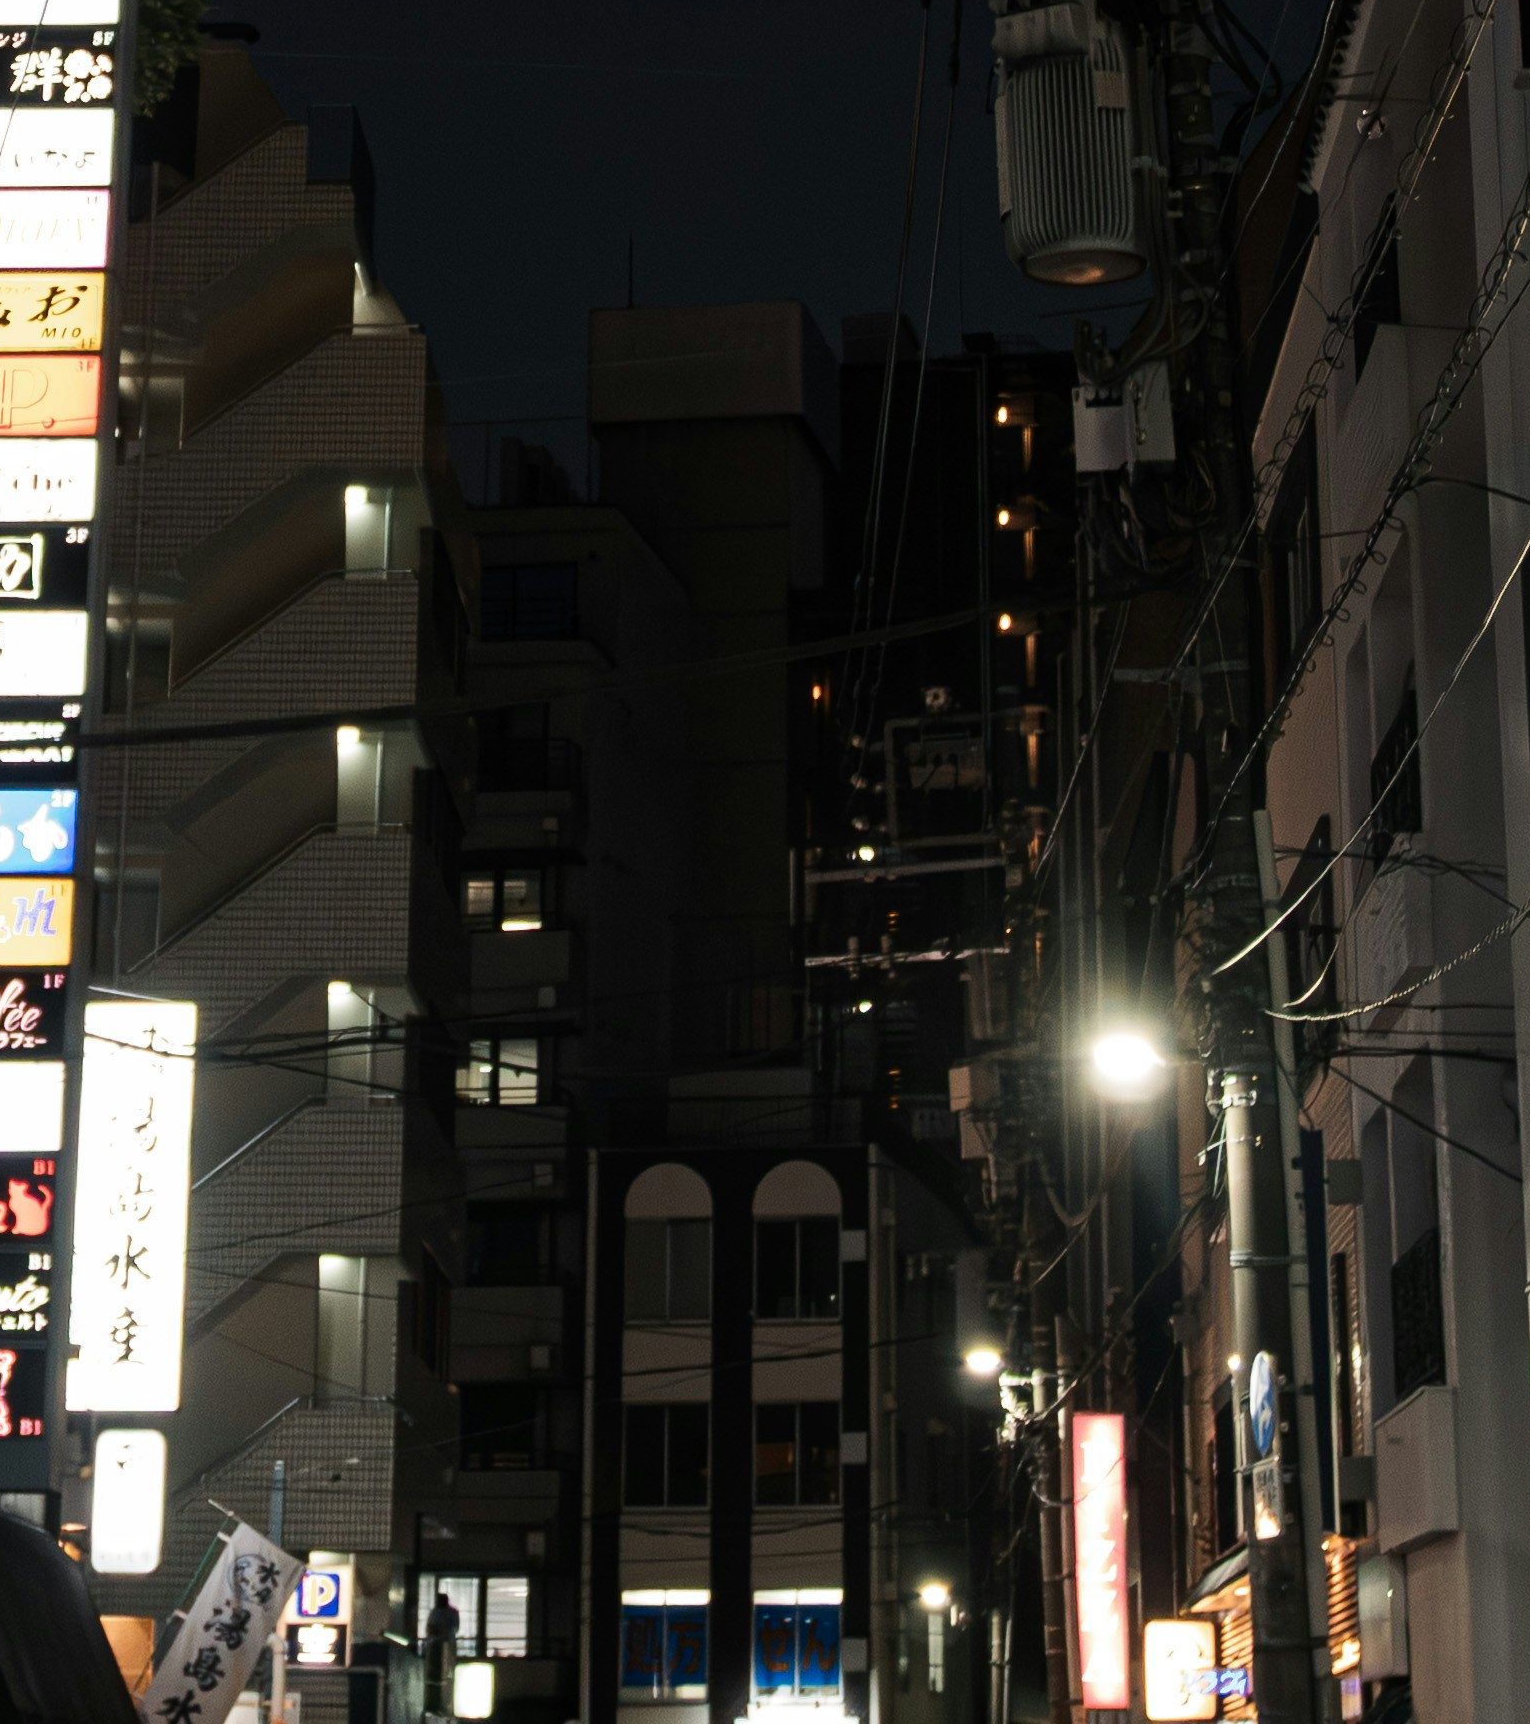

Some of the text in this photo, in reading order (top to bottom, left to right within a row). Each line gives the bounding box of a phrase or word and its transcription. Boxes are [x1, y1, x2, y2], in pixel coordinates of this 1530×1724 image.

[41, 327, 82, 339] MIO
[42, 973, 66, 990] 1F
[32, 1159, 56, 1176] B1
[301, 1573, 337, 1616] P
